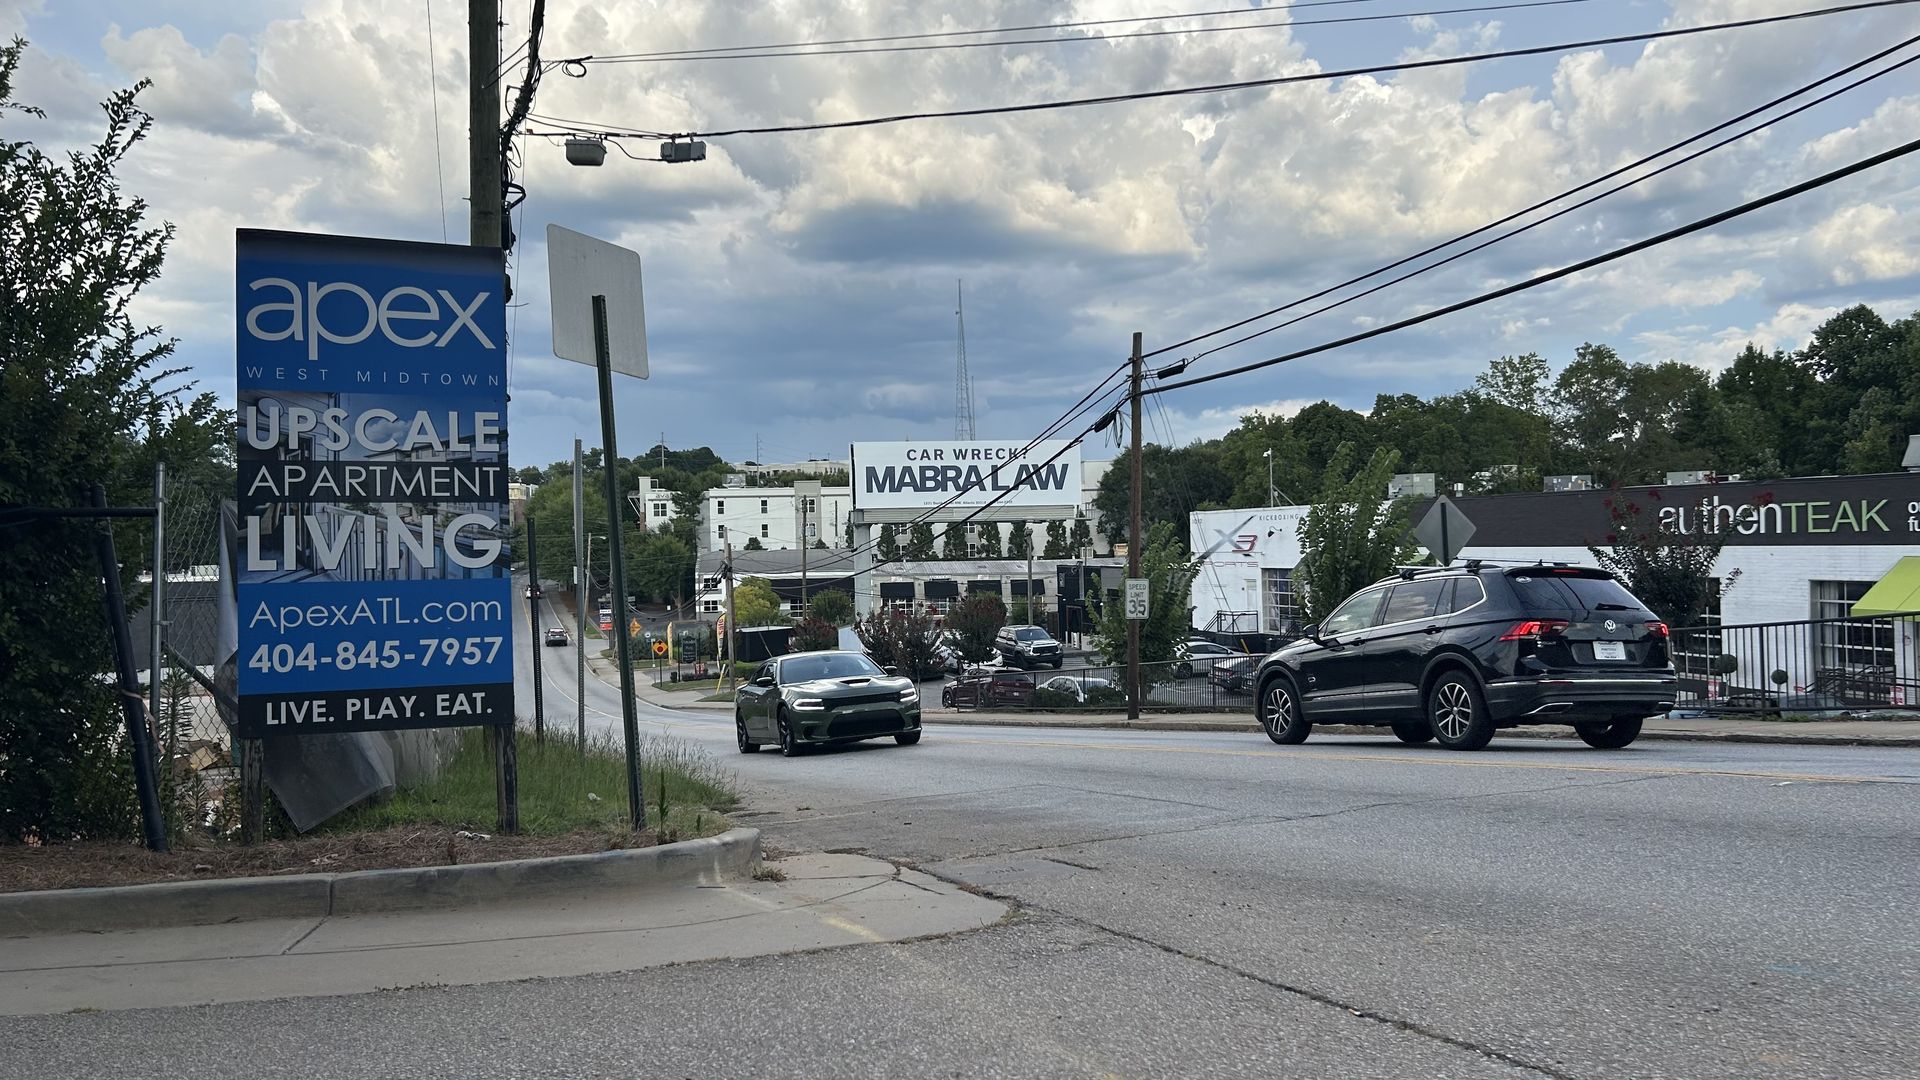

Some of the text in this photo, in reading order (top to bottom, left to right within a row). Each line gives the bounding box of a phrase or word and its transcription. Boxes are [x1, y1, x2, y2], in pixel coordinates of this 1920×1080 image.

[246, 277, 497, 361] apex
[246, 366, 499, 386] WEST MIDTOWN
[247, 405, 500, 452] UPSCALE
[906, 448, 944, 461] CAR
[247, 465, 500, 497] APARTMENT
[865, 463, 1069, 493] MABRA LAW
[1259, 513, 1299, 521] KICKBOXING
[1658, 496, 1890, 535] authenTEAK
[247, 513, 502, 572] LIVING
[1128, 583, 1147, 591] SPEED
[1130, 591, 1144, 599] LIMIT
[249, 598, 502, 633] ApexATL.com
[1128, 599, 1147, 615] 35
[248, 636, 504, 673] 404-845-7957
[266, 692, 493, 725] LIVE. PLAY. EAT.
